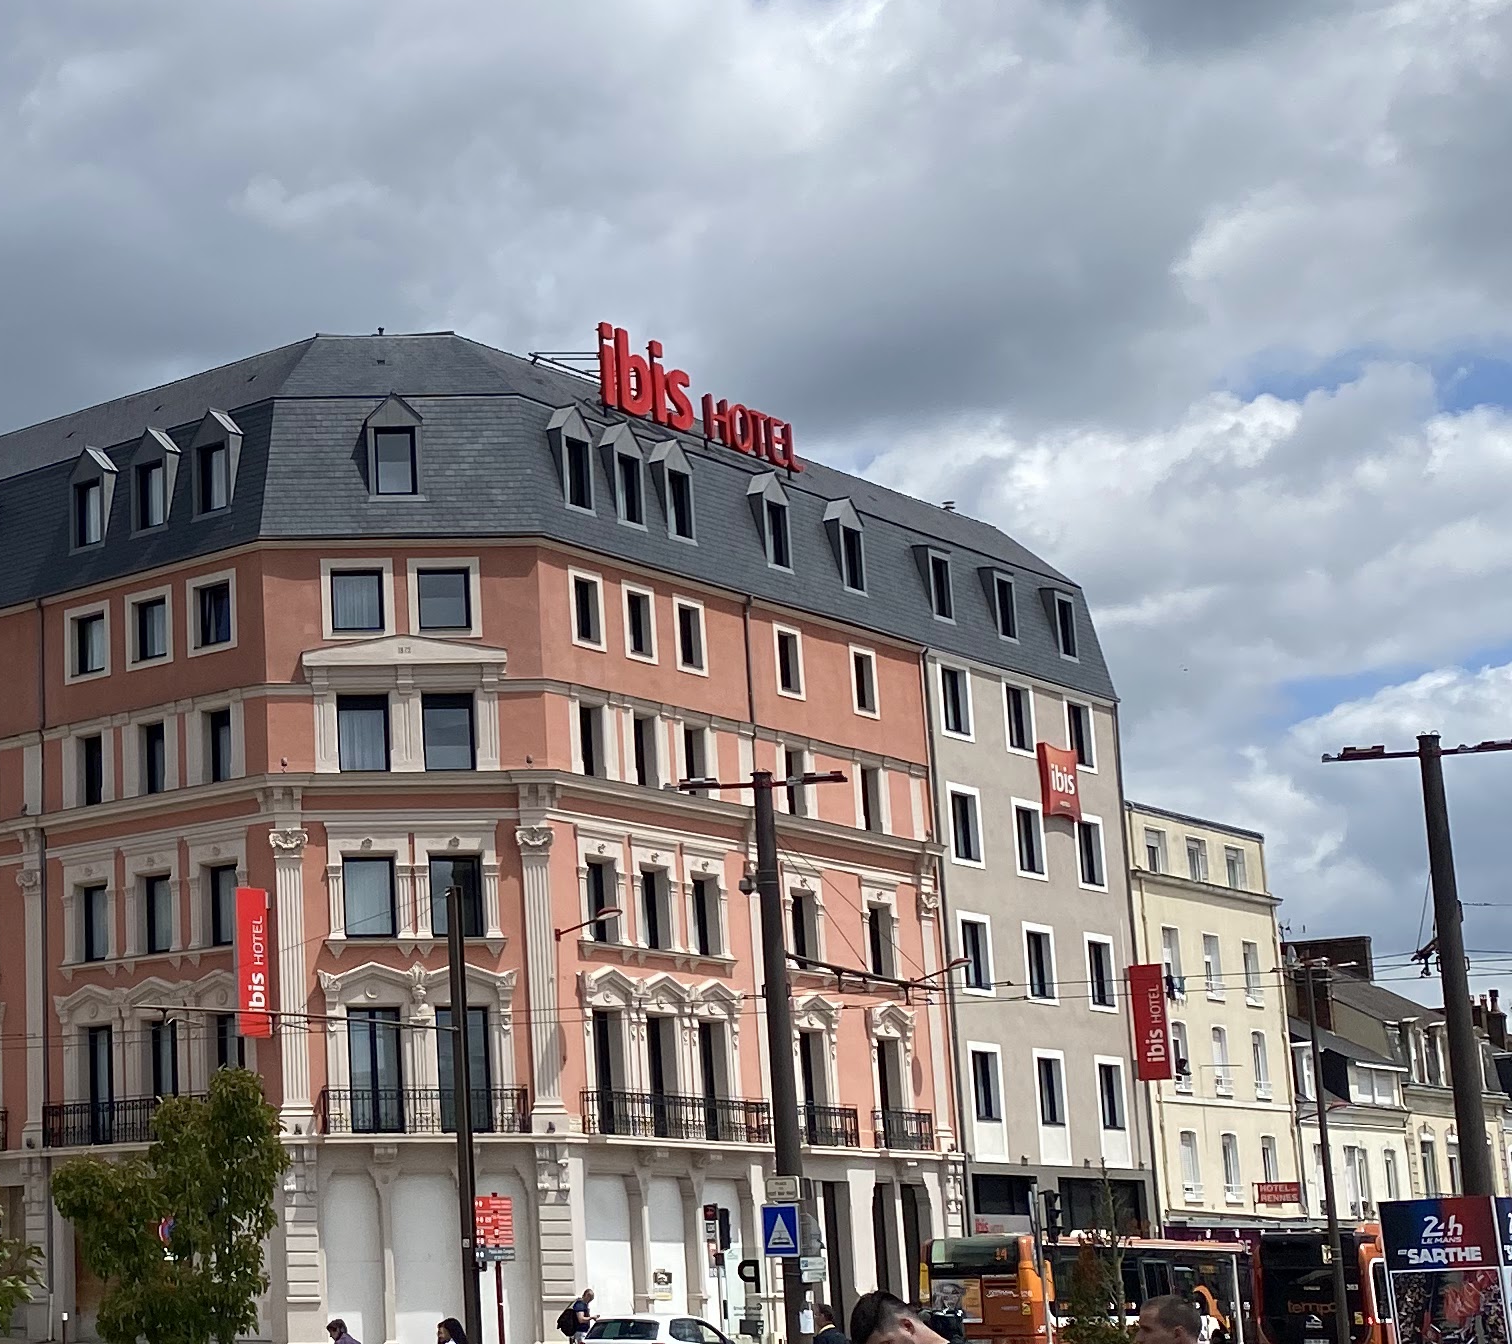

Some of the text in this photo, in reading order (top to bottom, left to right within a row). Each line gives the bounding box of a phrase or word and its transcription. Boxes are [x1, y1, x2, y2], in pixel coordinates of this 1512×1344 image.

[595, 322, 804, 473] ibis HOTEL
[1050, 762, 1076, 795] ibis
[248, 915, 266, 1012] HOTEL ibis
[1145, 984, 1166, 1062] HOTEL ibis
[1260, 1184, 1291, 1193] HOTEL
[1261, 1194, 1299, 1202] RENNES
[1421, 1236, 1463, 1245] LE MANS
[1407, 1246, 1483, 1265] SARTHE
